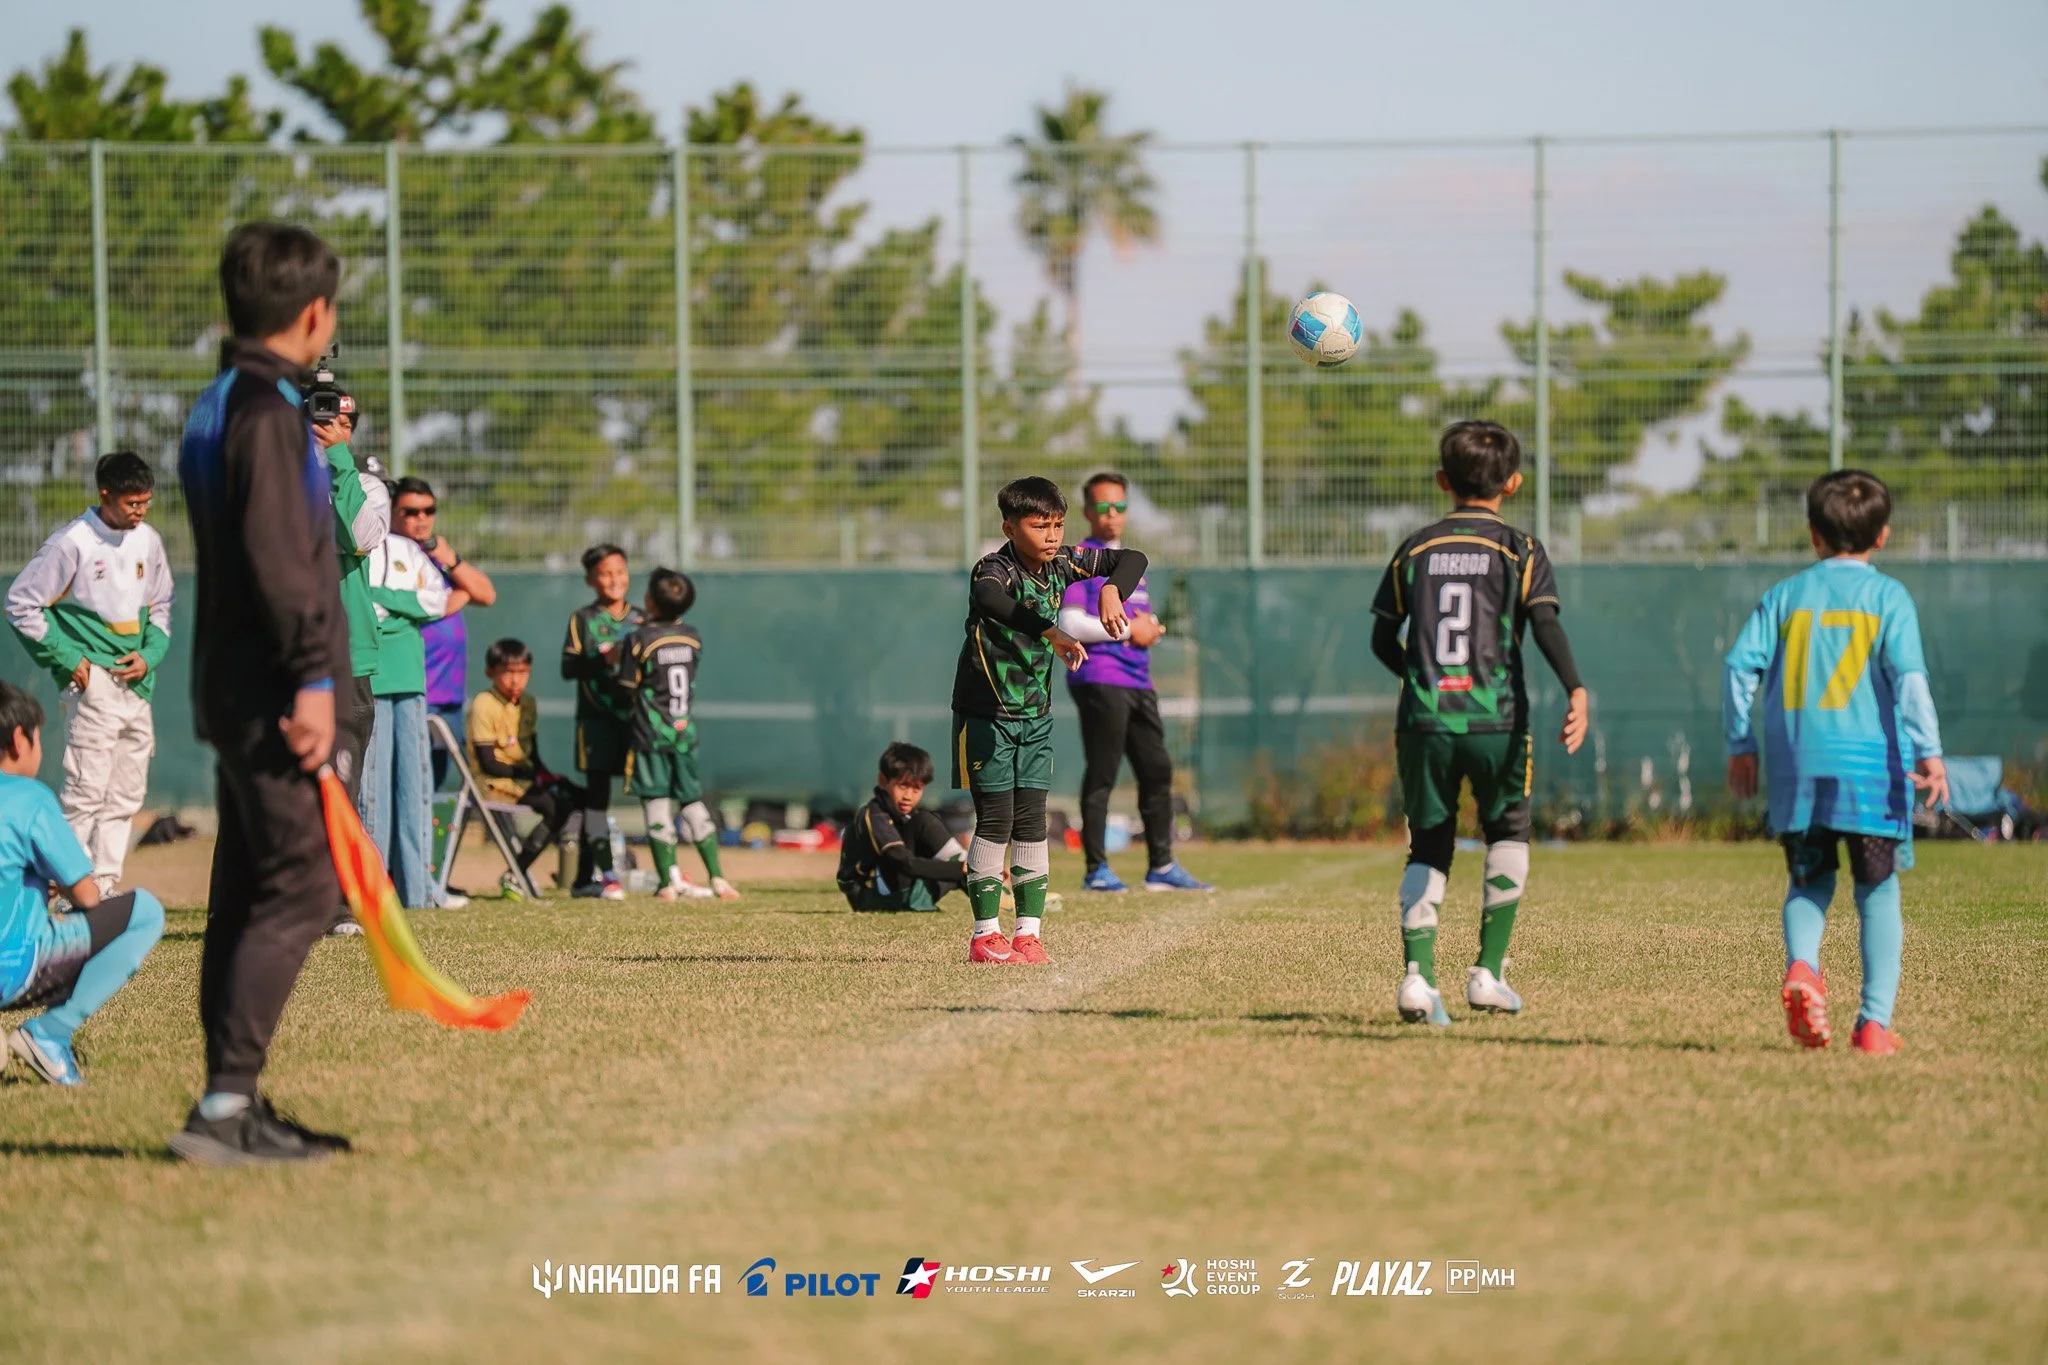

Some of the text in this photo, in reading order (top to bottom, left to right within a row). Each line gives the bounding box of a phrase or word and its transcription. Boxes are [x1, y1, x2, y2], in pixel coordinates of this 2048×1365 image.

[1435, 581, 1473, 666] 2
[1779, 607, 1882, 712] 17
[667, 665, 689, 717] 9
